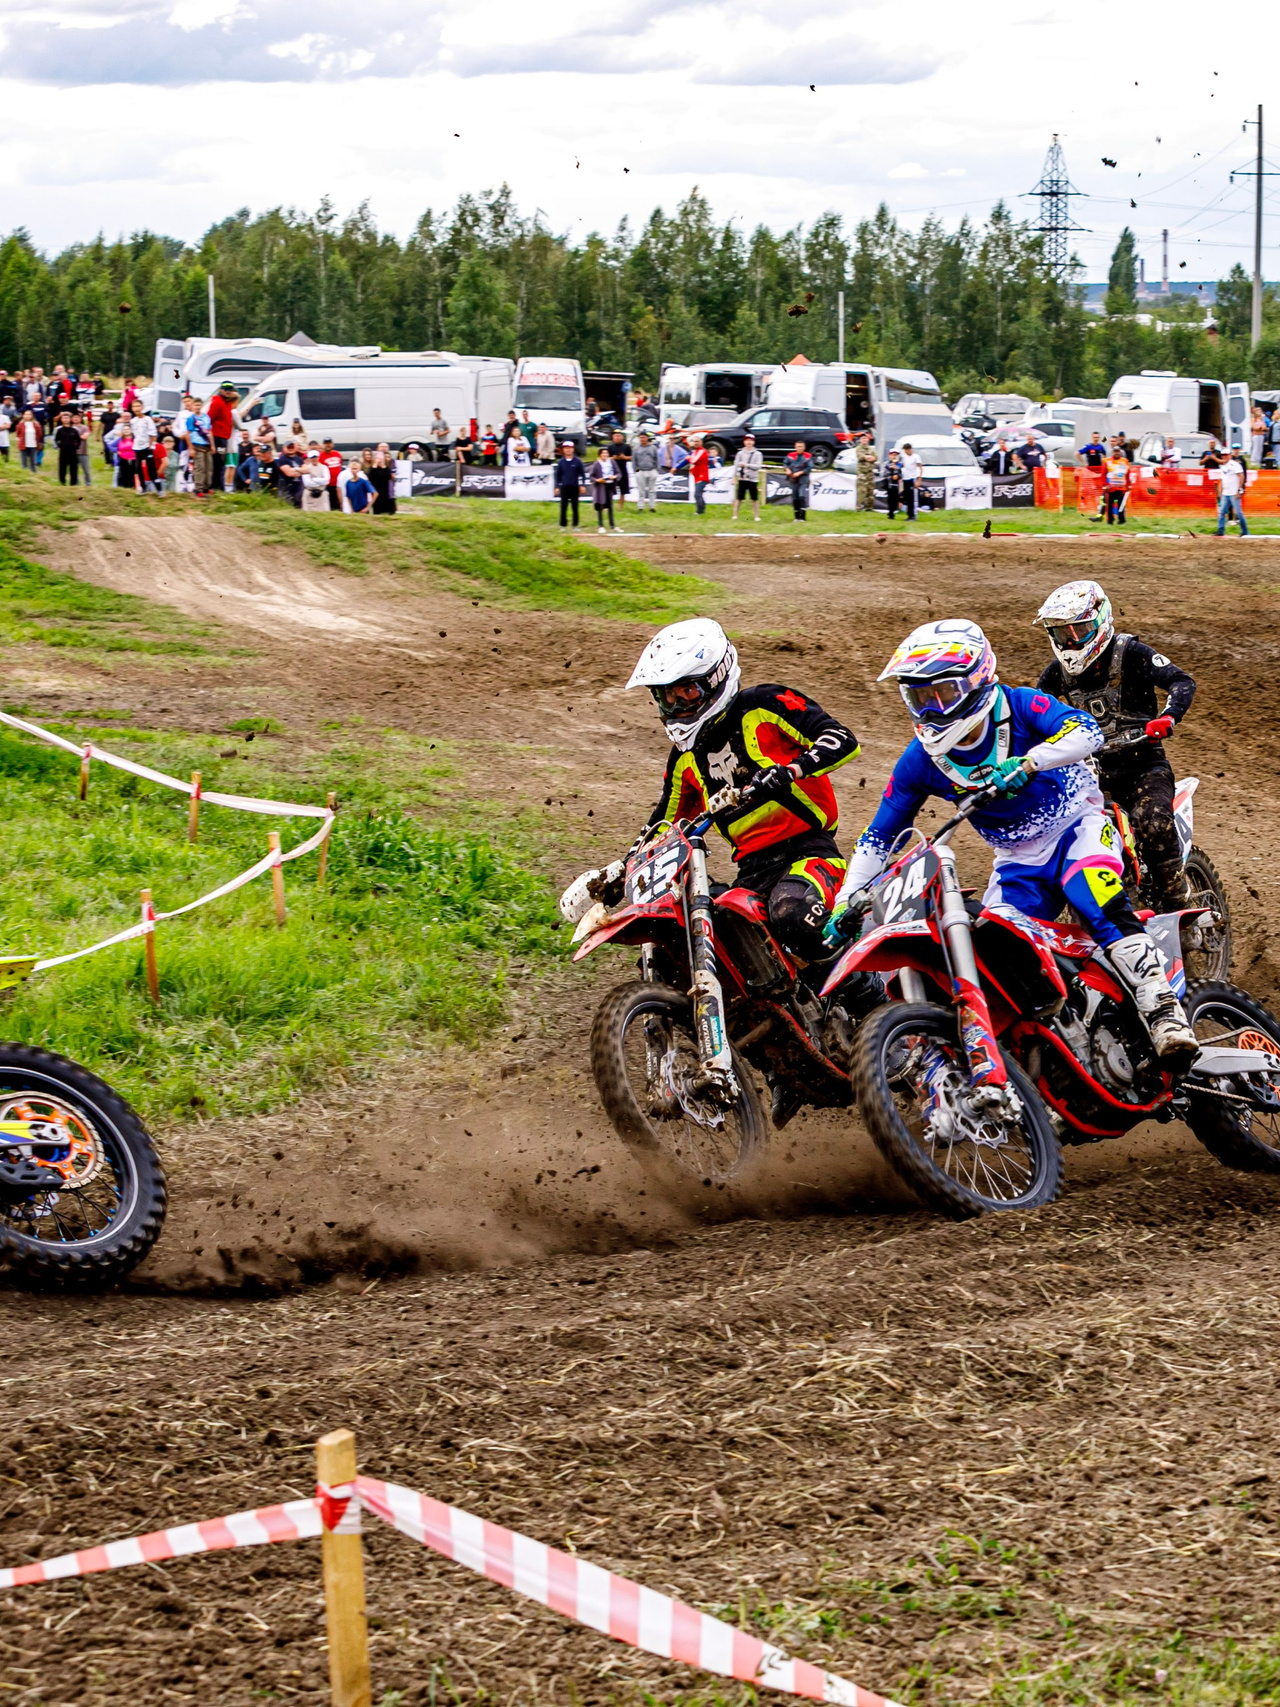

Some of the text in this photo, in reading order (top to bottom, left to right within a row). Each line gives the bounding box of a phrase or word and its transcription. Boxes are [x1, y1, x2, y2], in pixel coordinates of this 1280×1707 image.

[521, 373, 578, 386] MOTOCROSS
[420, 476, 456, 486] thor
[821, 487, 853, 496] thor
[631, 846, 680, 905] 25
[883, 856, 928, 925] 24
[701, 1018, 713, 1055] DUNLOP
